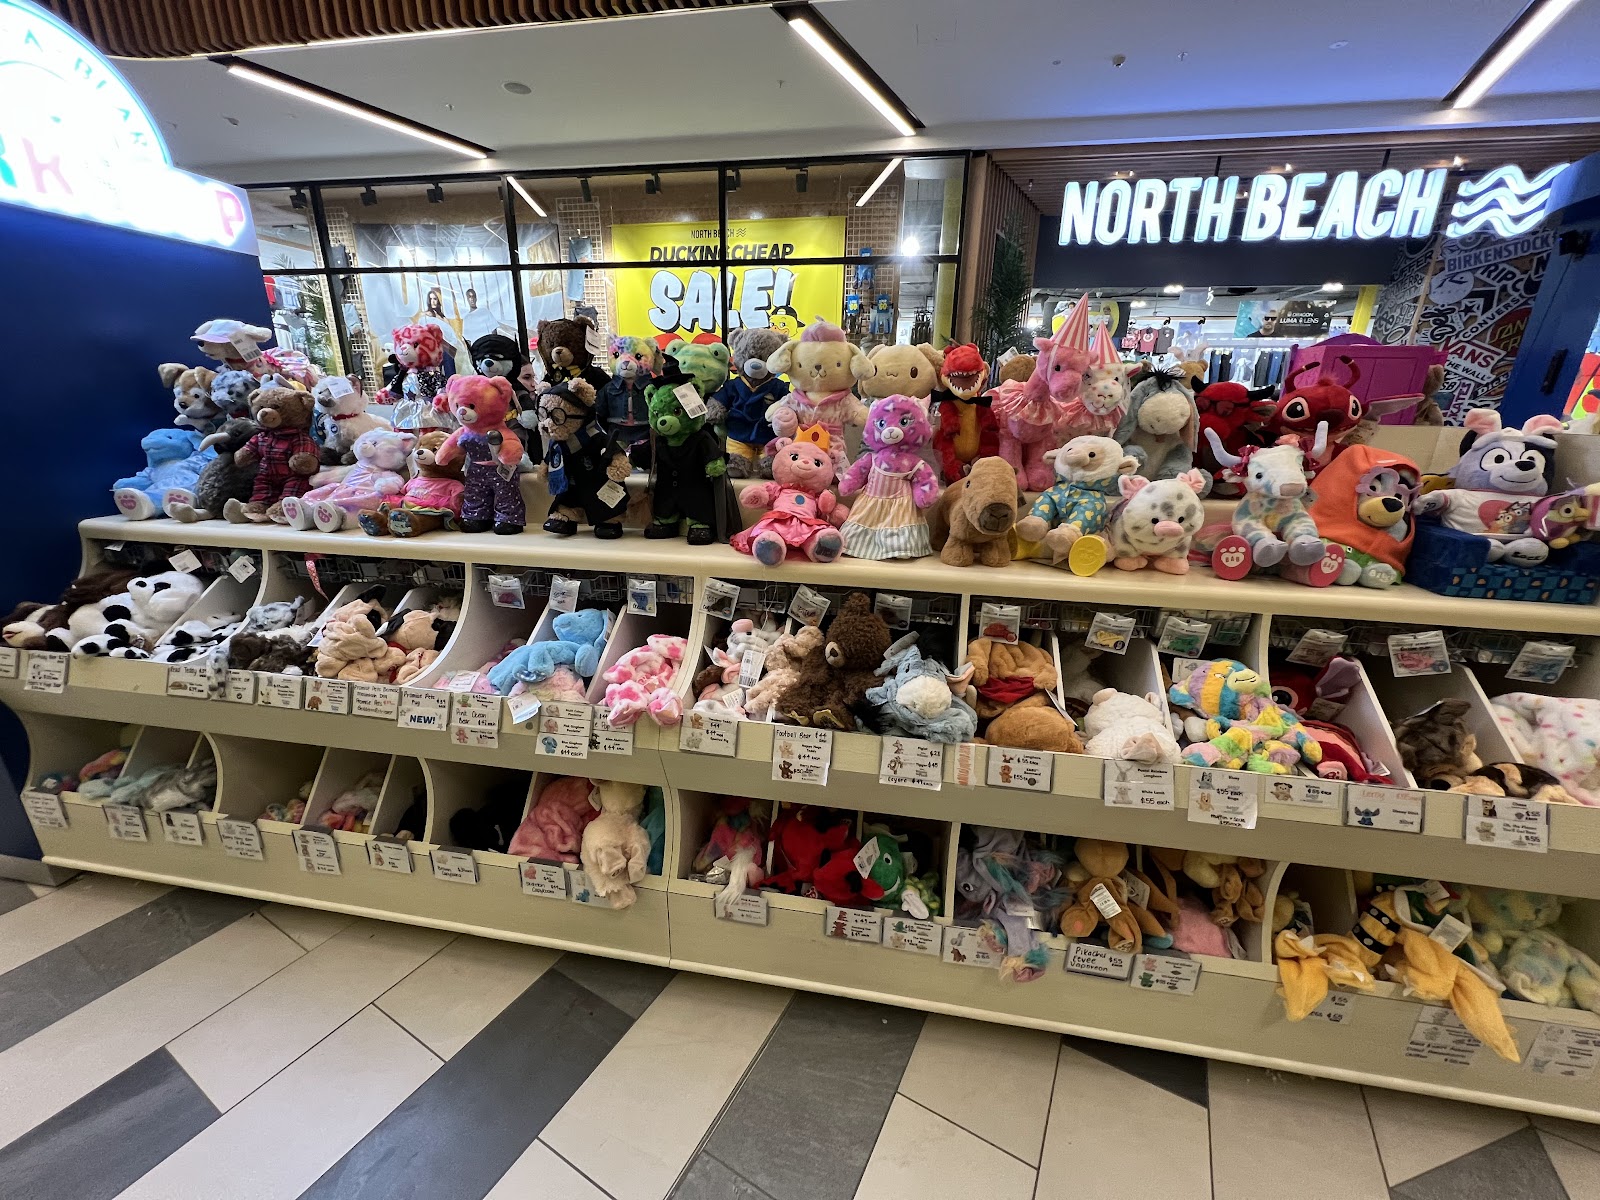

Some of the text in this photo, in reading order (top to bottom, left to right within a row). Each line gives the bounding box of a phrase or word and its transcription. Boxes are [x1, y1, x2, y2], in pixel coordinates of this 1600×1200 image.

[1058, 168, 1448, 246] NORTH BEACH
[691, 228, 735, 239] NORTH BECH
[730, 243, 794, 260] CHEAP
[1447, 233, 1552, 272] BIRKENSTOCK
[648, 267, 796, 333] SALE!
[1461, 296, 1524, 339] CONVERS
[1442, 336, 1496, 369] VANS
[1224, 555, 1241, 564] BAB
[409, 714, 436, 725] NEW!
[1075, 947, 1106, 959] Pikachu
